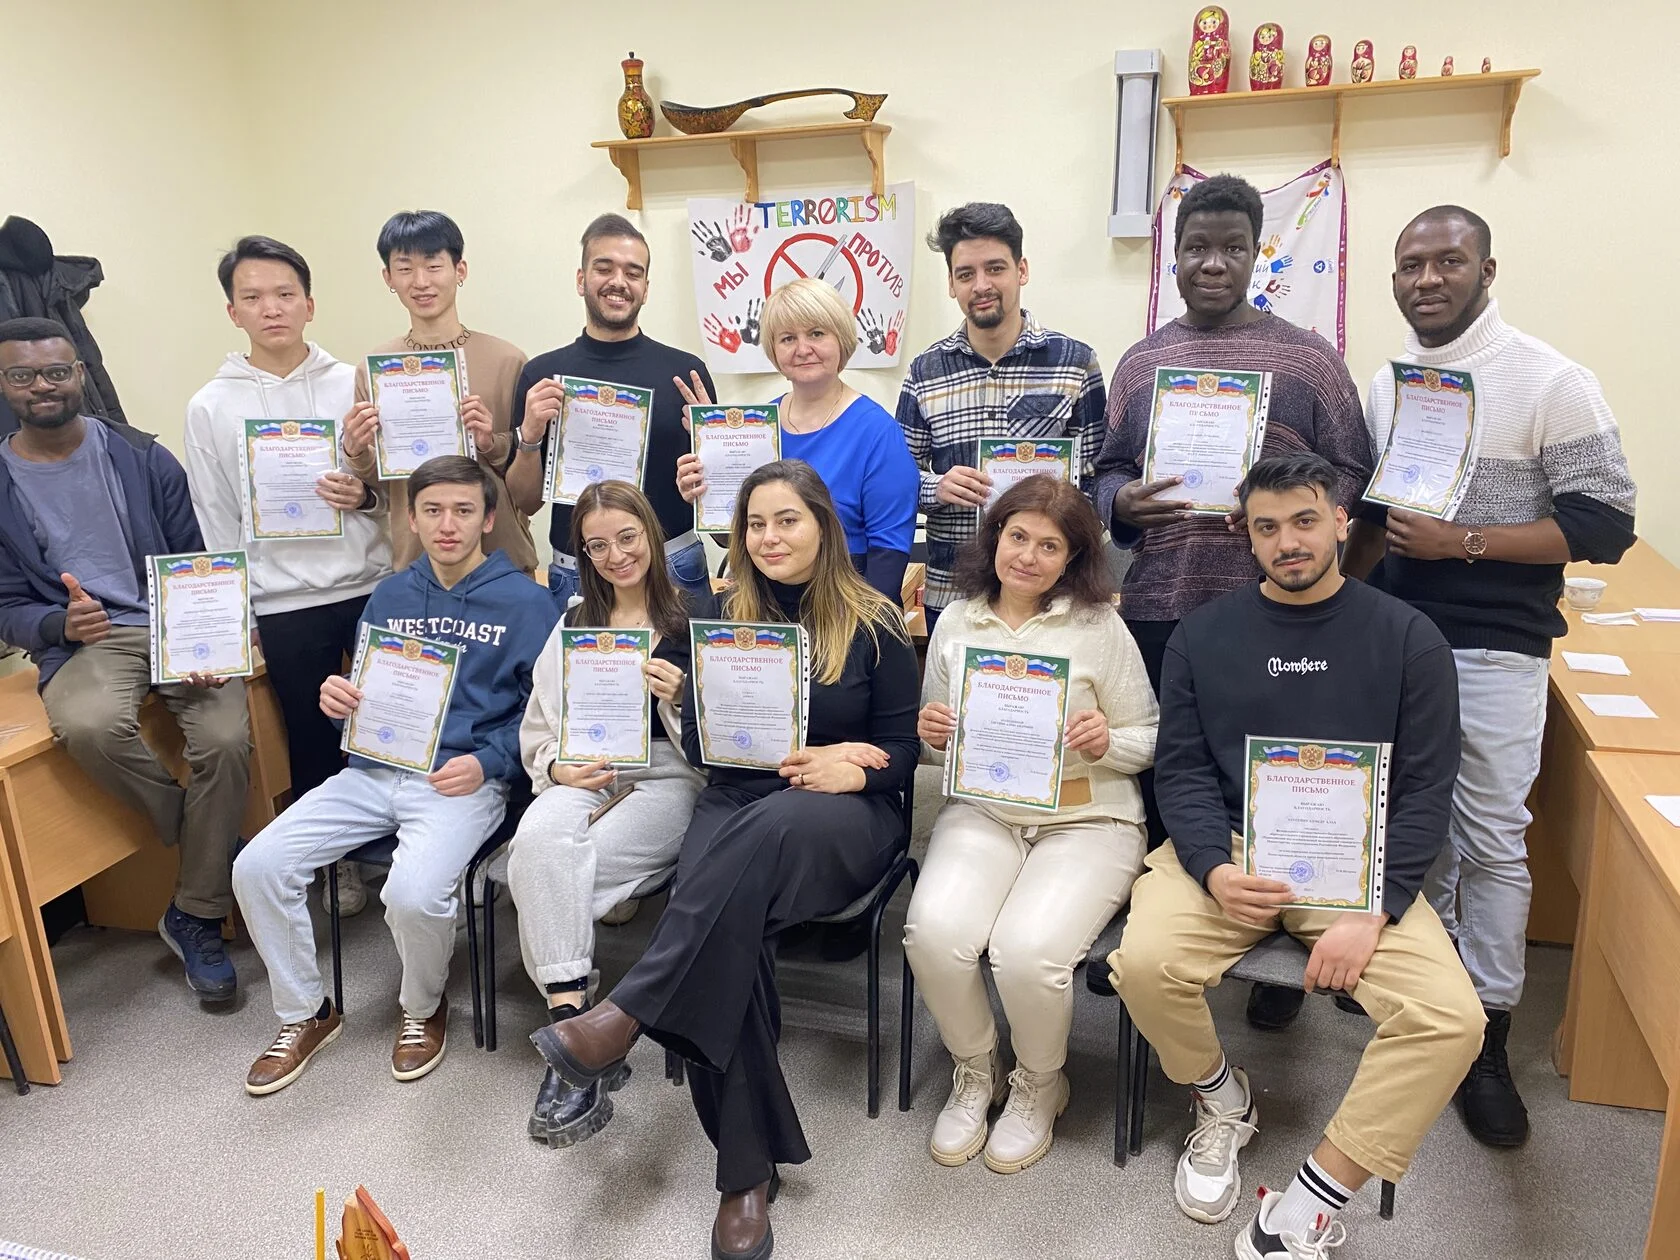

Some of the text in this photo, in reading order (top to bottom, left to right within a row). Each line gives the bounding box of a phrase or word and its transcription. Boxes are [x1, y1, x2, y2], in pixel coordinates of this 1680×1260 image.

[848, 232, 904, 298] ПРОТИВ
[712, 261, 750, 300] МЫ
[387, 617, 506, 646] WESTCOAST
[710, 655, 784, 665] БЛАГОДАРСТВЕННОЕ
[730, 664, 762, 672] ПИСЬМО
[1267, 657, 1328, 677] Nowhere
[977, 681, 1052, 696] БЛАГОДАРСТВЕННОЕ
[998, 693, 1029, 702] ПИСЬМО
[1266, 775, 1356, 786] БЛАГОДАРСТВЕННОЕ
[1292, 786, 1329, 795] ПИСЬМО
